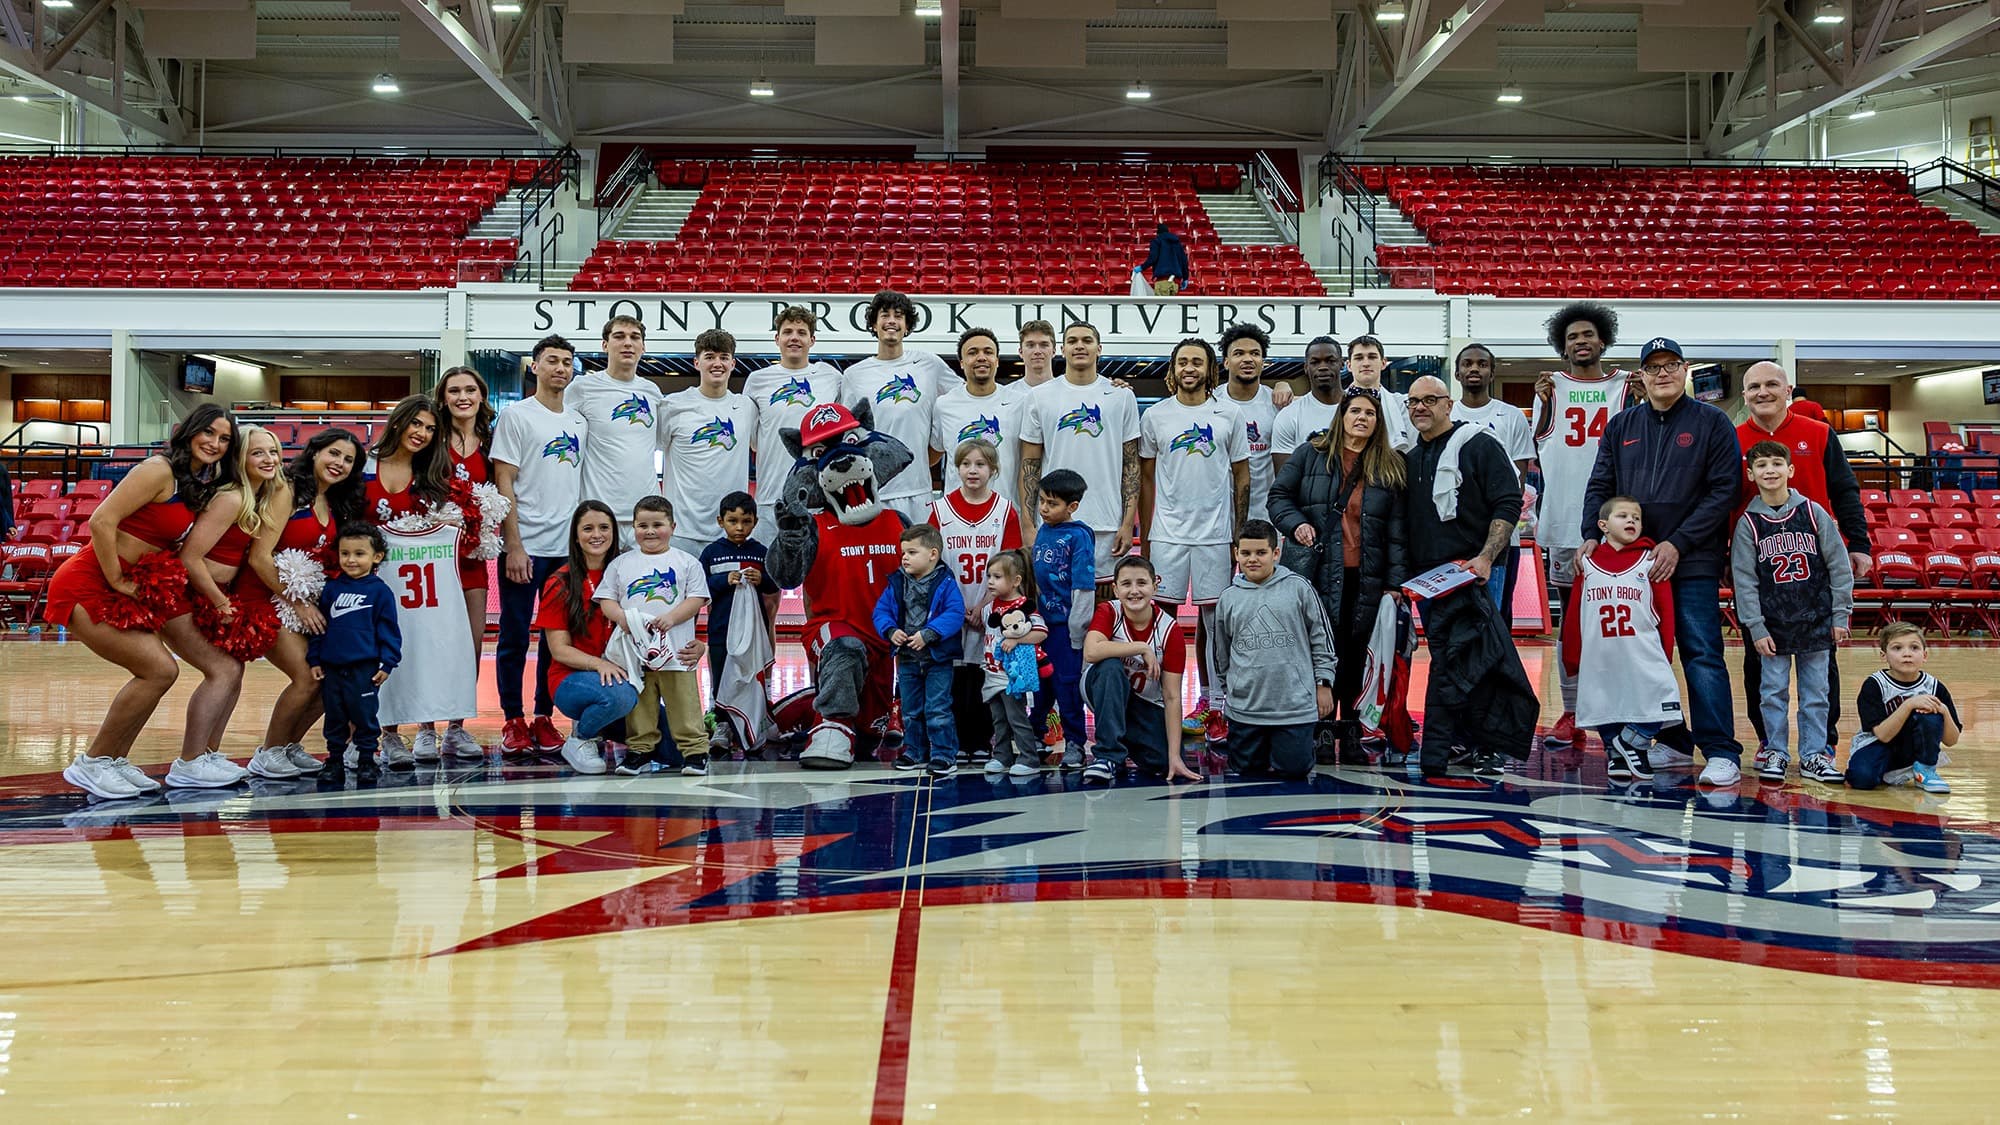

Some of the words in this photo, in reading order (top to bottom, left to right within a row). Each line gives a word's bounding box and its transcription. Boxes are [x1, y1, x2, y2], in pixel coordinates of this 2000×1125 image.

[534, 300, 734, 332] STONY
[1010, 303, 1386, 336] UNIVERSITY
[1569, 390, 1608, 403] RIVERA
[1564, 406, 1609, 447] 34
[840, 545, 866, 557] STONY
[869, 544, 897, 555] BROOK
[947, 535, 973, 550] STONY
[1758, 531, 1818, 562] JORDAN
[866, 559, 875, 584] 1
[958, 553, 989, 585] 32
[1770, 551, 1811, 584] 23
[398, 562, 439, 609] 31
[1586, 586, 1613, 602] STONY
[335, 593, 368, 608] NIKE
[1599, 604, 1637, 638] 22
[1232, 634, 1297, 651] adidas
